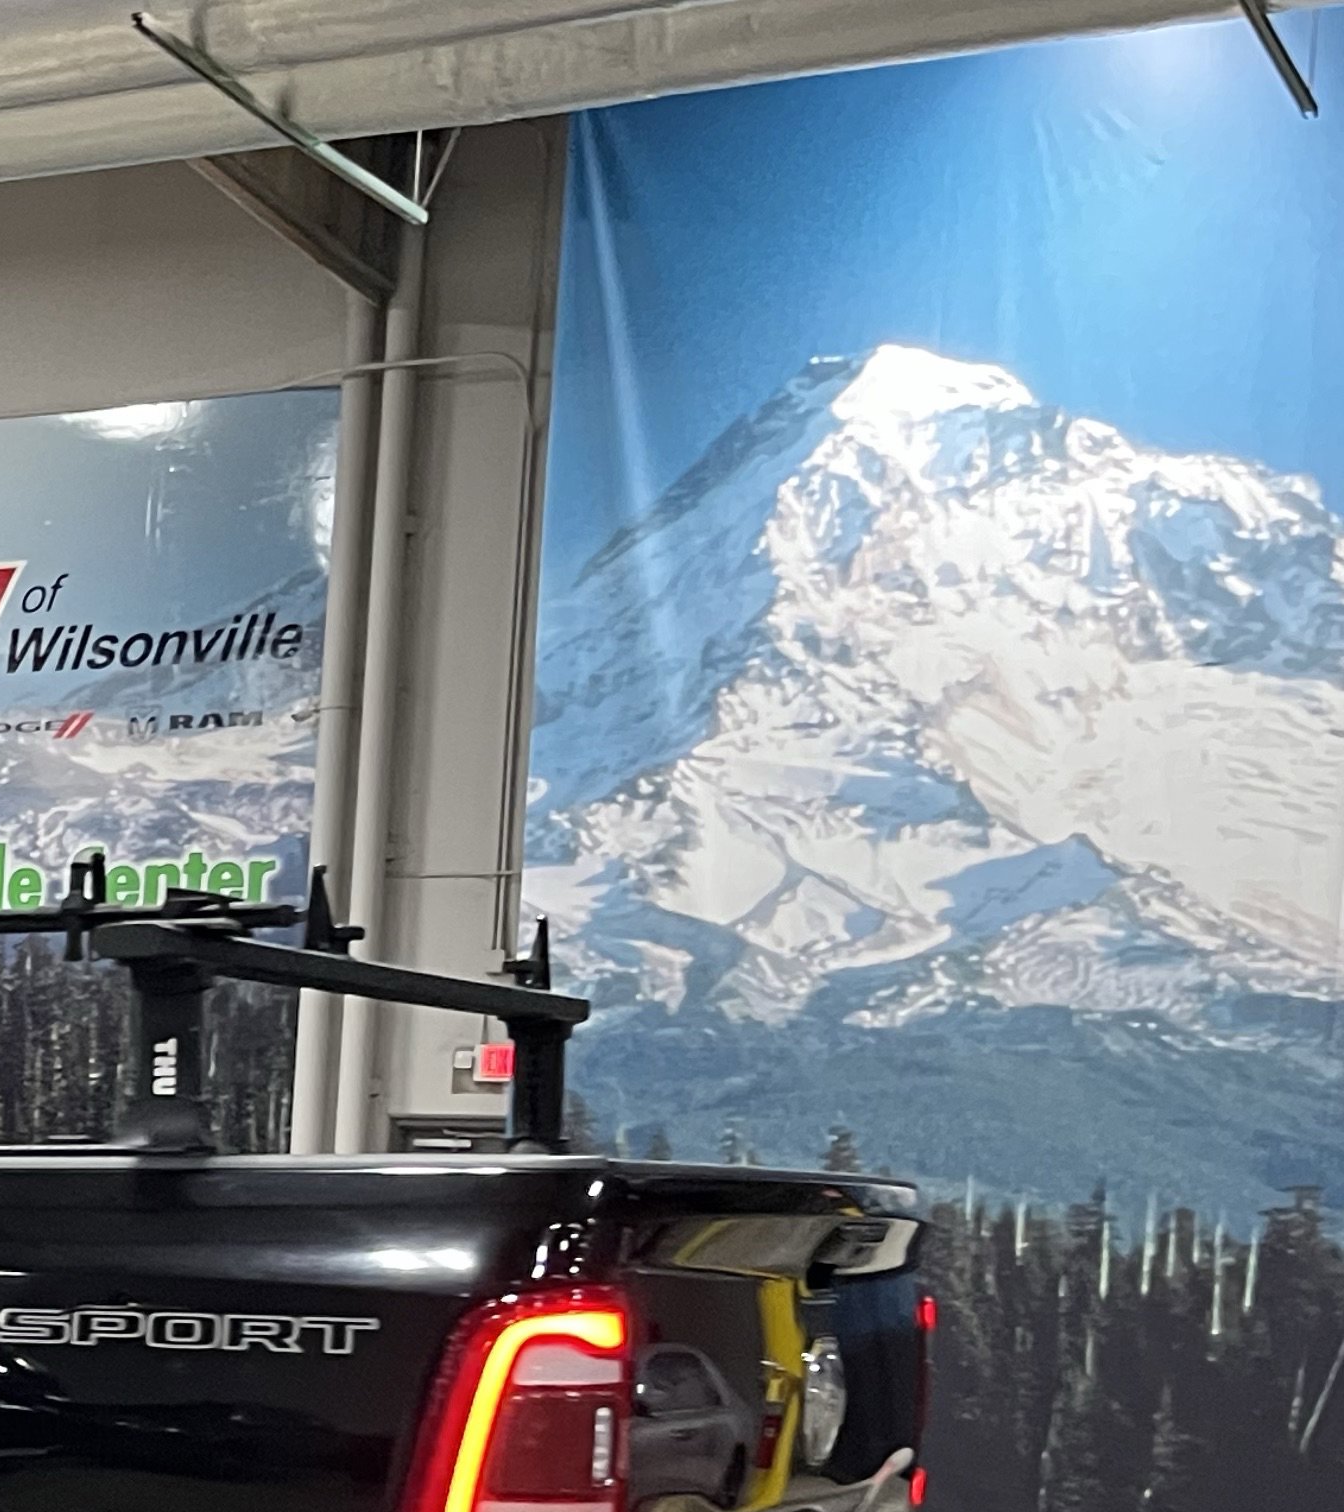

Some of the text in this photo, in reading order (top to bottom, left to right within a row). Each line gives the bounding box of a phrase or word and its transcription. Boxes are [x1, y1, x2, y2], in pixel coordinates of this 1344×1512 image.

[21, 573, 70, 613] of
[6, 612, 304, 675] Wilsonville
[169, 710, 264, 730] RAM
[71, 846, 276, 904] enter
[152, 1038, 178, 1096] THU
